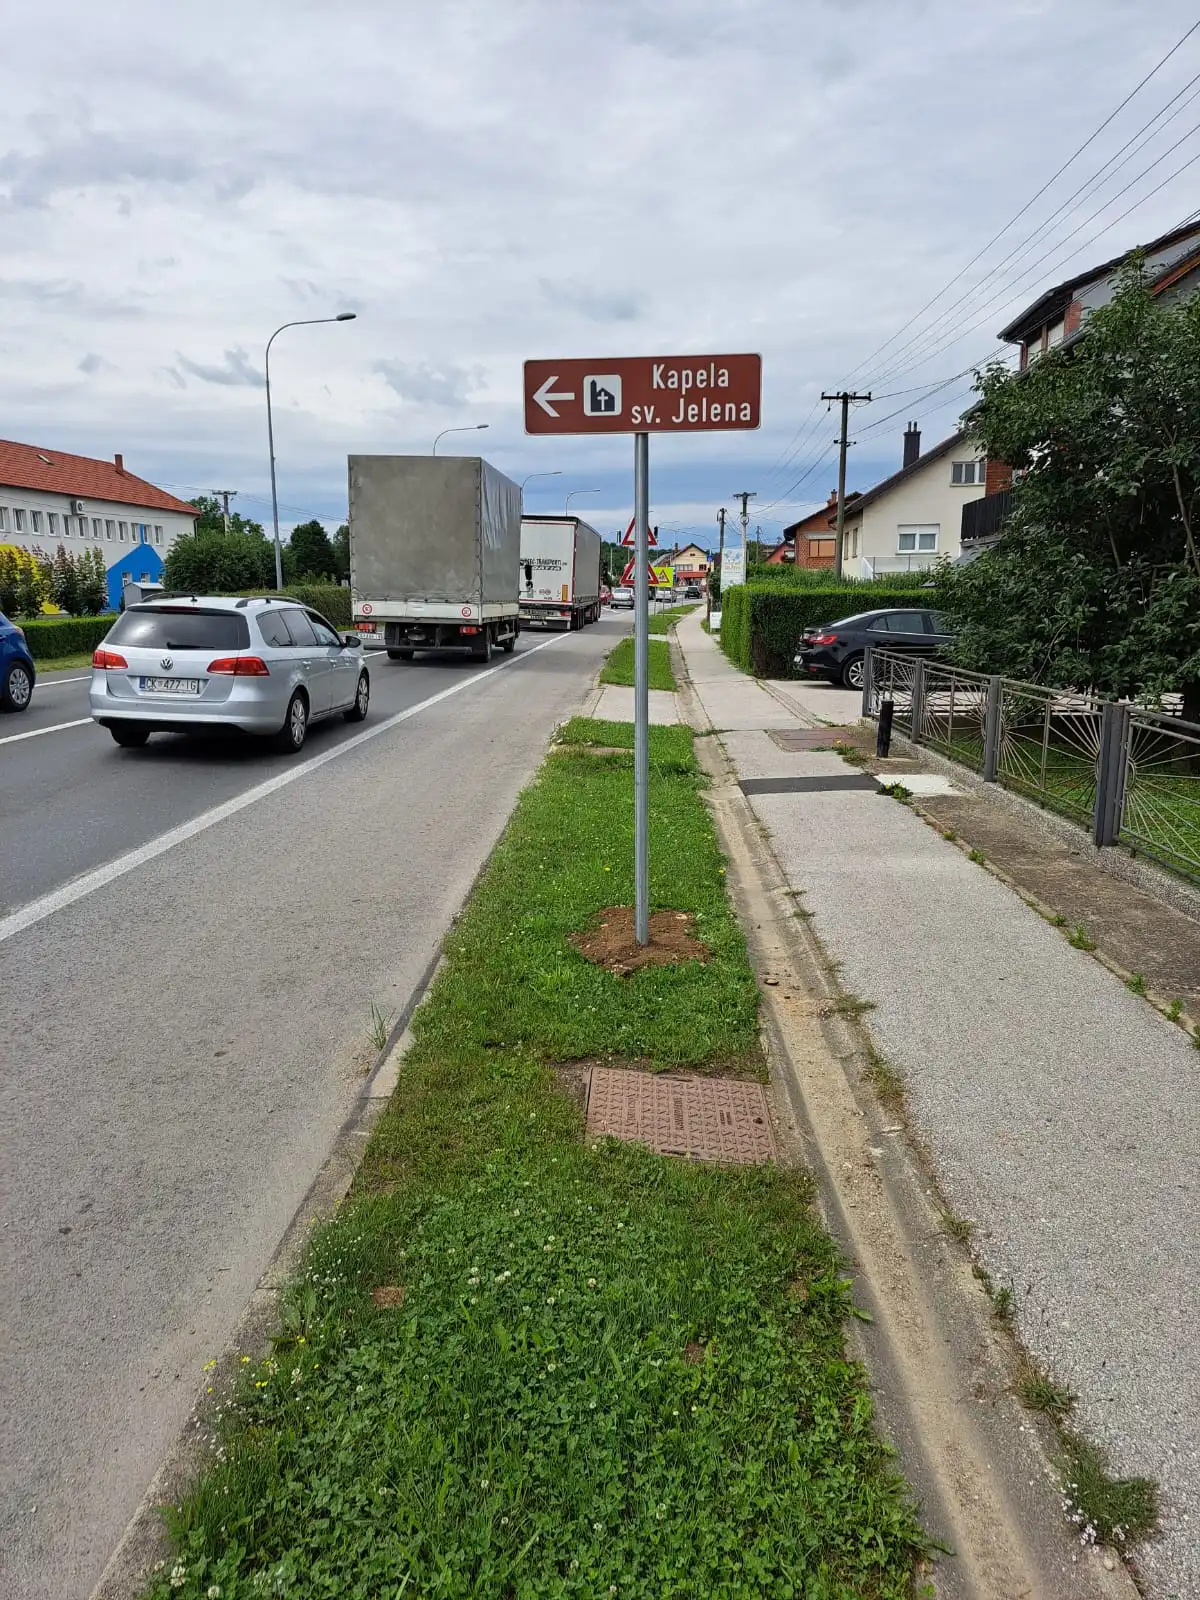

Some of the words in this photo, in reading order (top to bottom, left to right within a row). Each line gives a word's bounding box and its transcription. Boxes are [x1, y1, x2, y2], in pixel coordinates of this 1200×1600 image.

[653, 363, 728, 395] Kapela
[632, 406, 660, 423] sv.
[672, 398, 750, 422] Jelena
